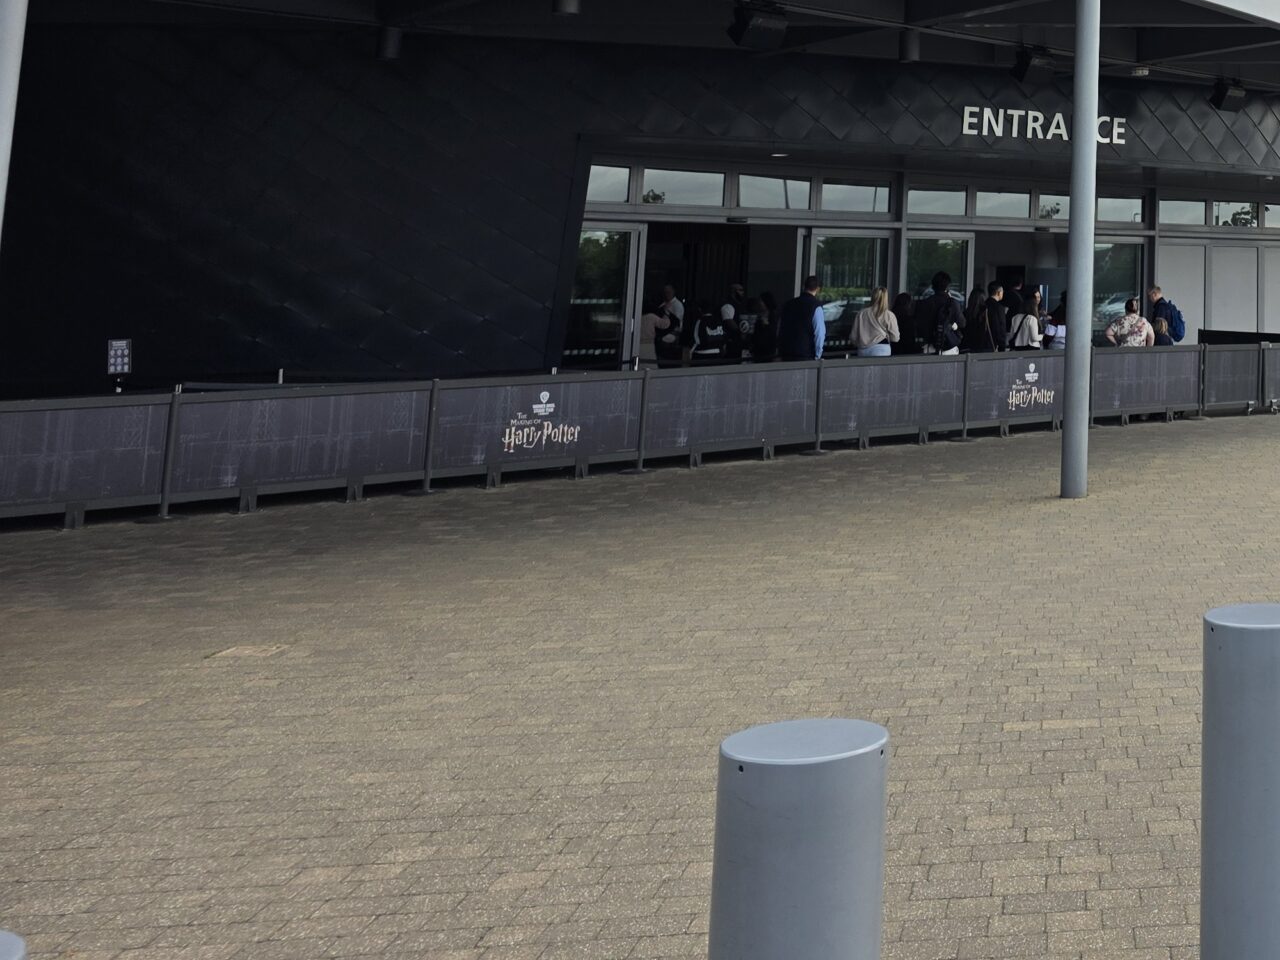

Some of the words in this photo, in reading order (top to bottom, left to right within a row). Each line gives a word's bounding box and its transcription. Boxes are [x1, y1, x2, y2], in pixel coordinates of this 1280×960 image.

[962, 105, 1127, 145] ENTRACE
[1008, 390, 1031, 411] Harry
[1031, 386, 1055, 408] Potter
[502, 426, 541, 453] Harry
[541, 421, 581, 451] Potter
